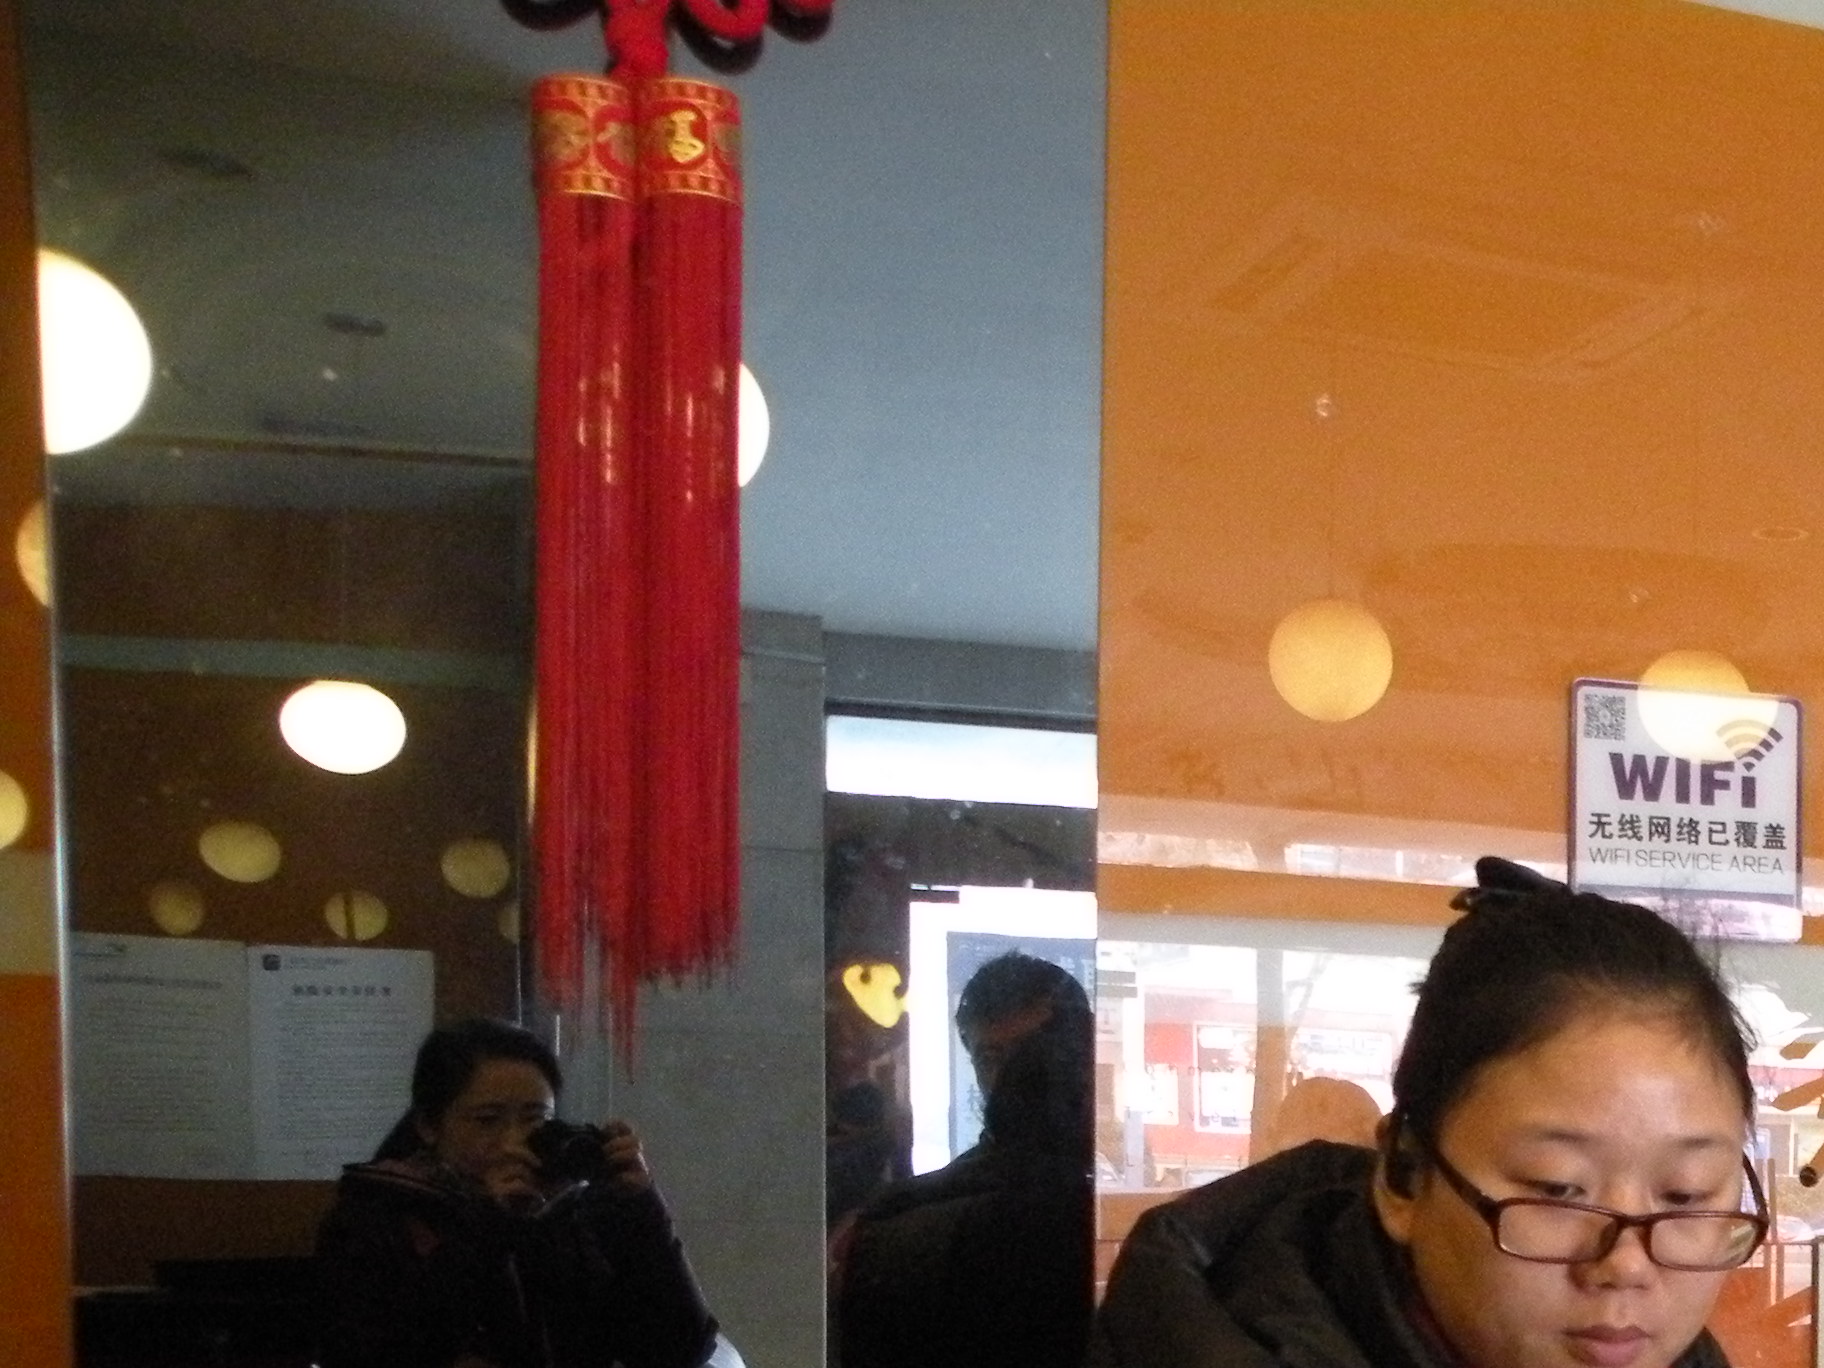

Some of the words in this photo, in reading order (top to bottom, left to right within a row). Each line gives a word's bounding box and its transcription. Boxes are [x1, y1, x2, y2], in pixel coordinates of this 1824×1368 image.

[1587, 811, 1788, 851] 无线网络已覆盖
[1589, 847, 1631, 866] WIFI
[1634, 849, 1723, 872] SERVICE
[1727, 854, 1785, 875] AREA
